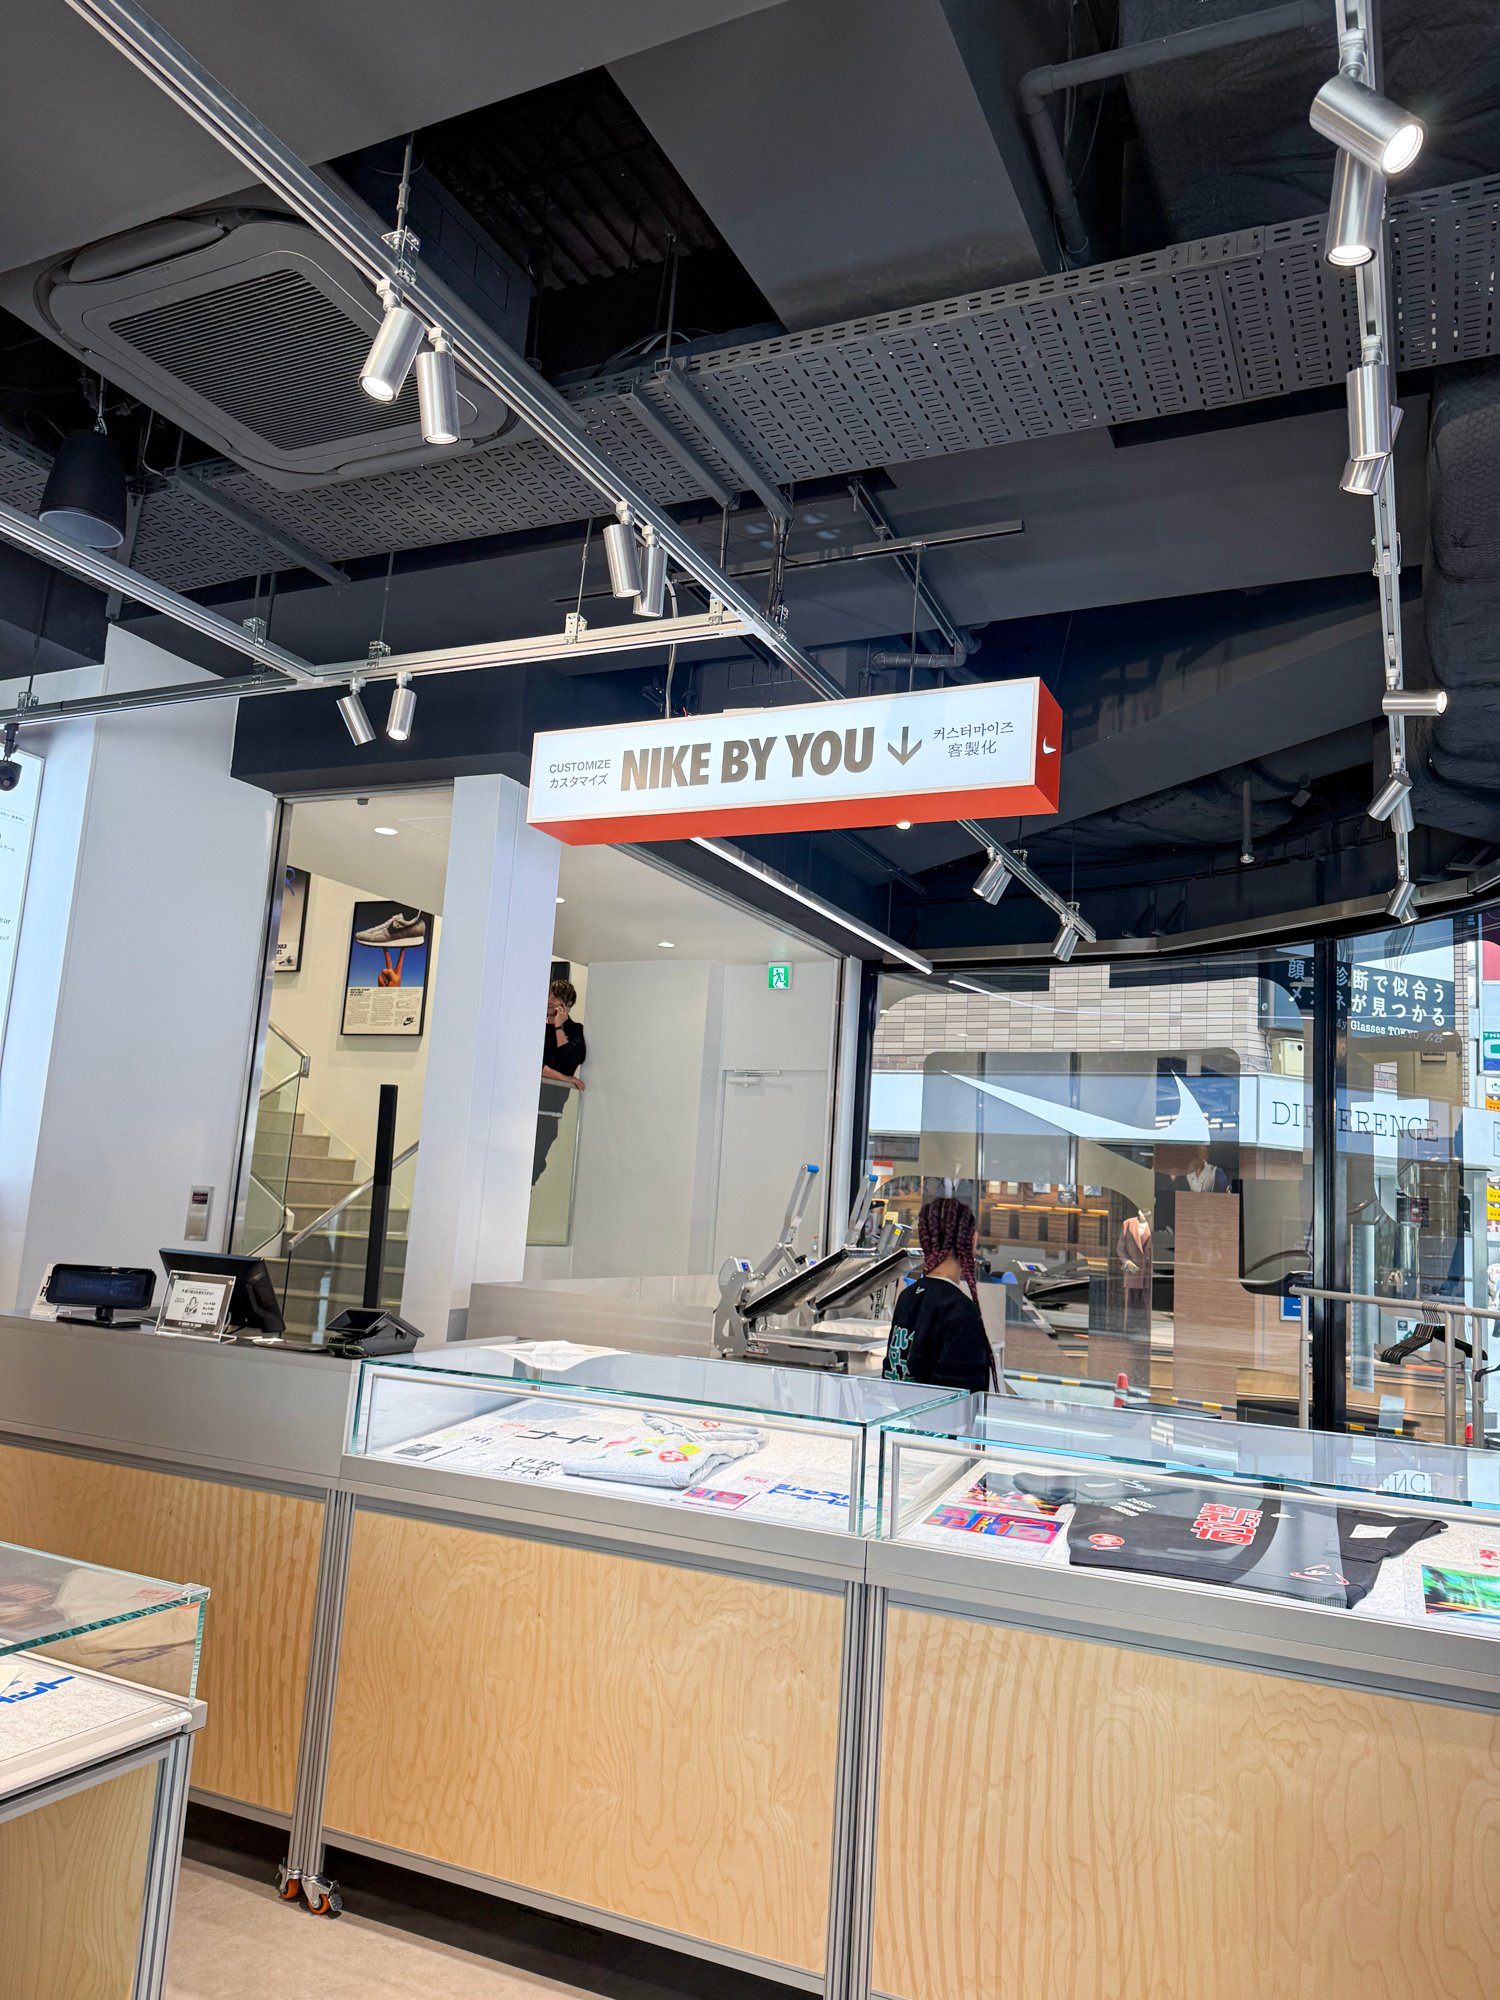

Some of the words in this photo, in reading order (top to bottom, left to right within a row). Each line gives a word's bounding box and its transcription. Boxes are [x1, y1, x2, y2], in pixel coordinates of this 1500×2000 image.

[933, 721, 1014, 741] 커스터마이즈
[947, 739, 997, 758] 客製化
[549, 759, 611, 774] CUSTOMIZE
[620, 742, 712, 792] NIKE
[720, 736, 778, 784] BY
[785, 726, 875, 777] YOU
[549, 773, 609, 789] カスタマイズ
[1288, 959, 1444, 1003] 顔診断で似合う
[1291, 986, 1445, 1027] メネが見つかる
[1350, 1020, 1386, 1035] Glasses
[1387, 1026, 1419, 1040] TOKYO
[1272, 1100, 1439, 1142] DIFERENCE
